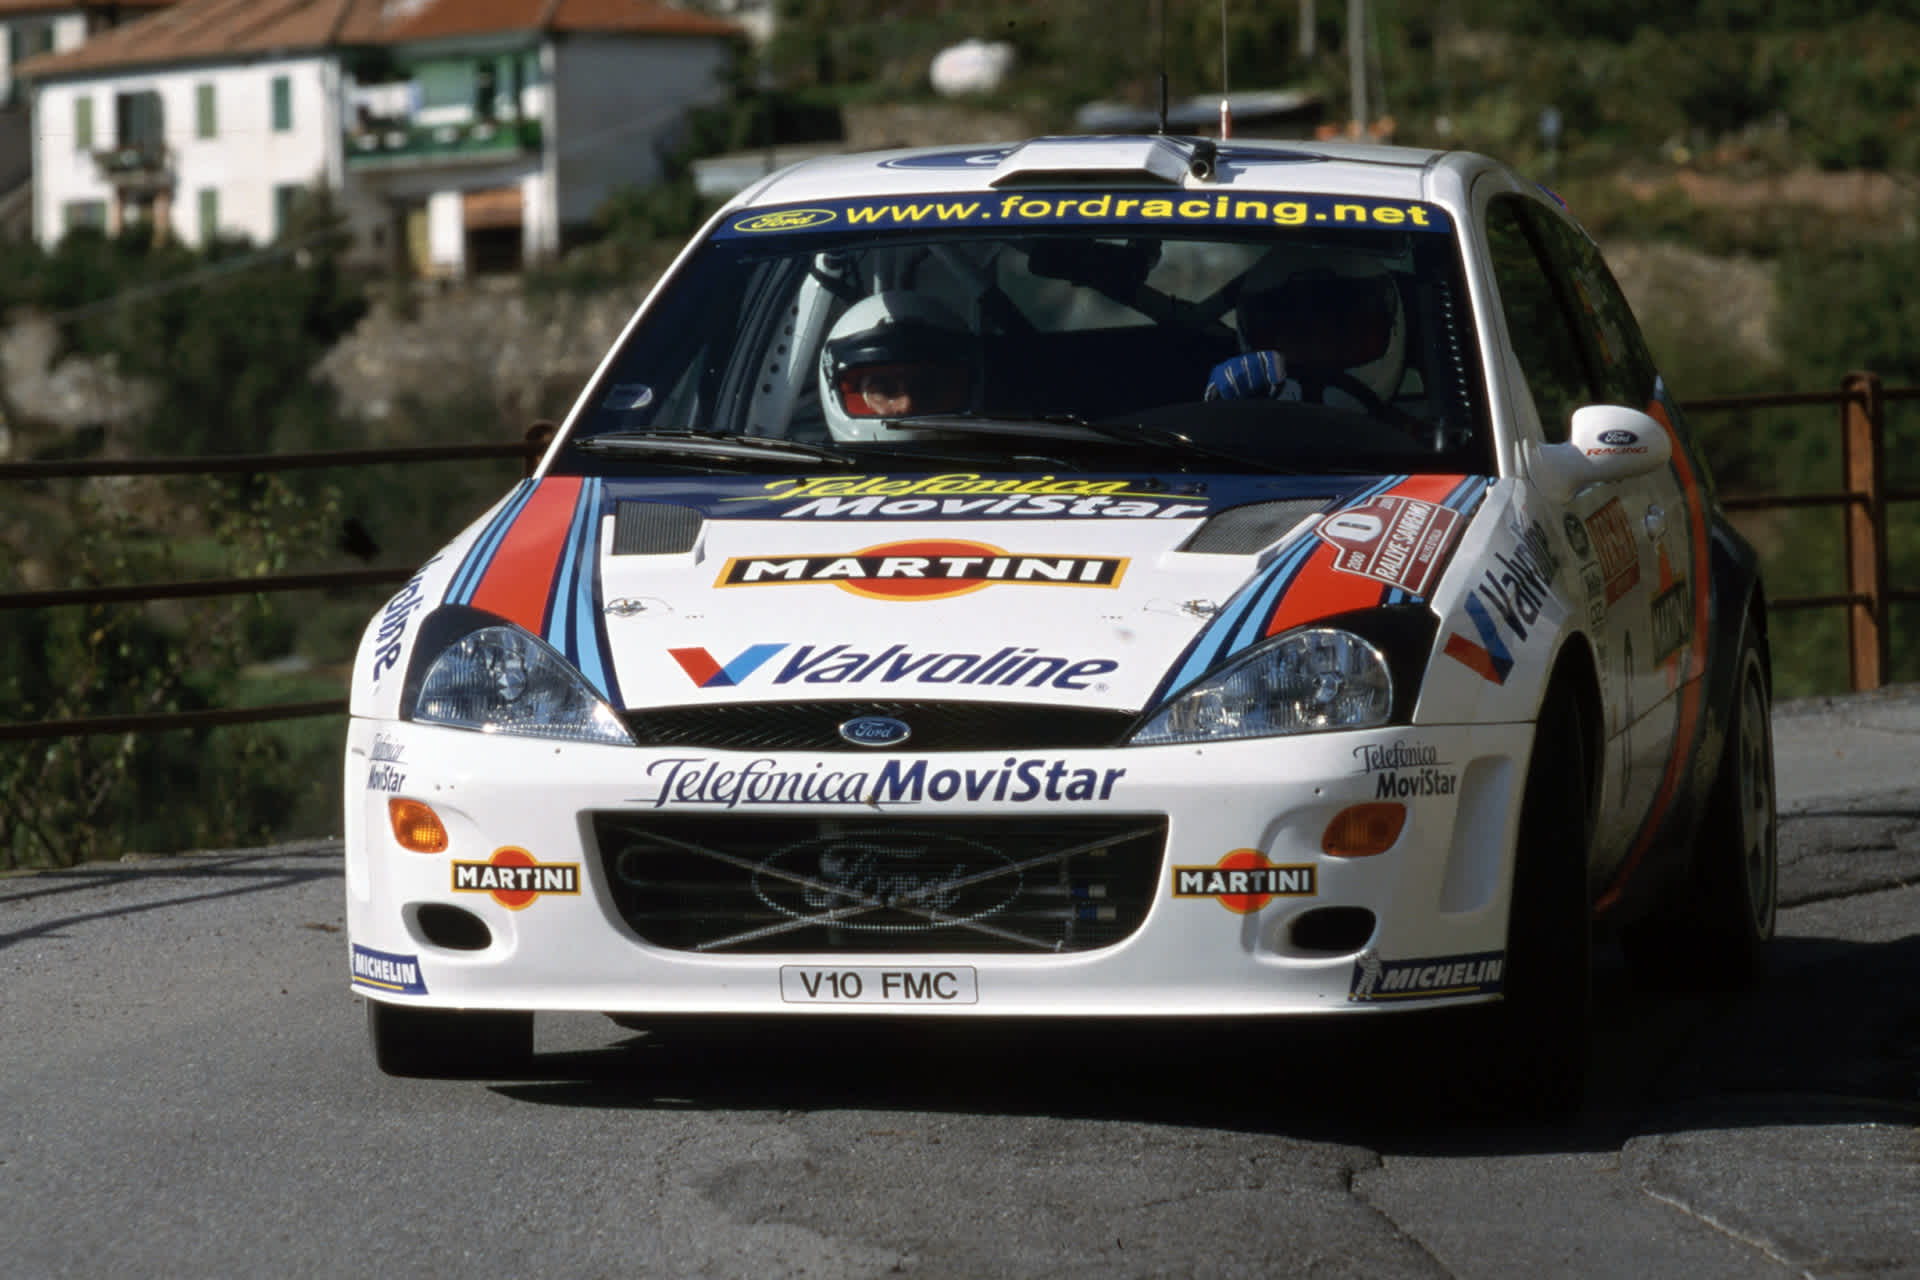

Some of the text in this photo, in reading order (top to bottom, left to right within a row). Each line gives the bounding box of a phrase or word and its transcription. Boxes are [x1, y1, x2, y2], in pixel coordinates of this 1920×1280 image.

[845, 194, 1430, 226] www.fordracing.net
[1586, 446, 1648, 457] RACING
[780, 493, 1209, 519] MoviStar
[741, 556, 1104, 583] MARTINI
[1373, 540, 1411, 580] RALLYE
[373, 555, 444, 681] oline
[772, 644, 1118, 690] Valvoline
[872, 757, 1127, 802] MoviStar
[1376, 768, 1456, 799] MoviStar
[457, 866, 573, 890] MARTINI
[1180, 868, 1310, 893] MARTINI
[355, 952, 417, 984] MICHELIN
[1381, 959, 1503, 991] MICHELIN
[800, 971, 958, 1000] V10 FMC
